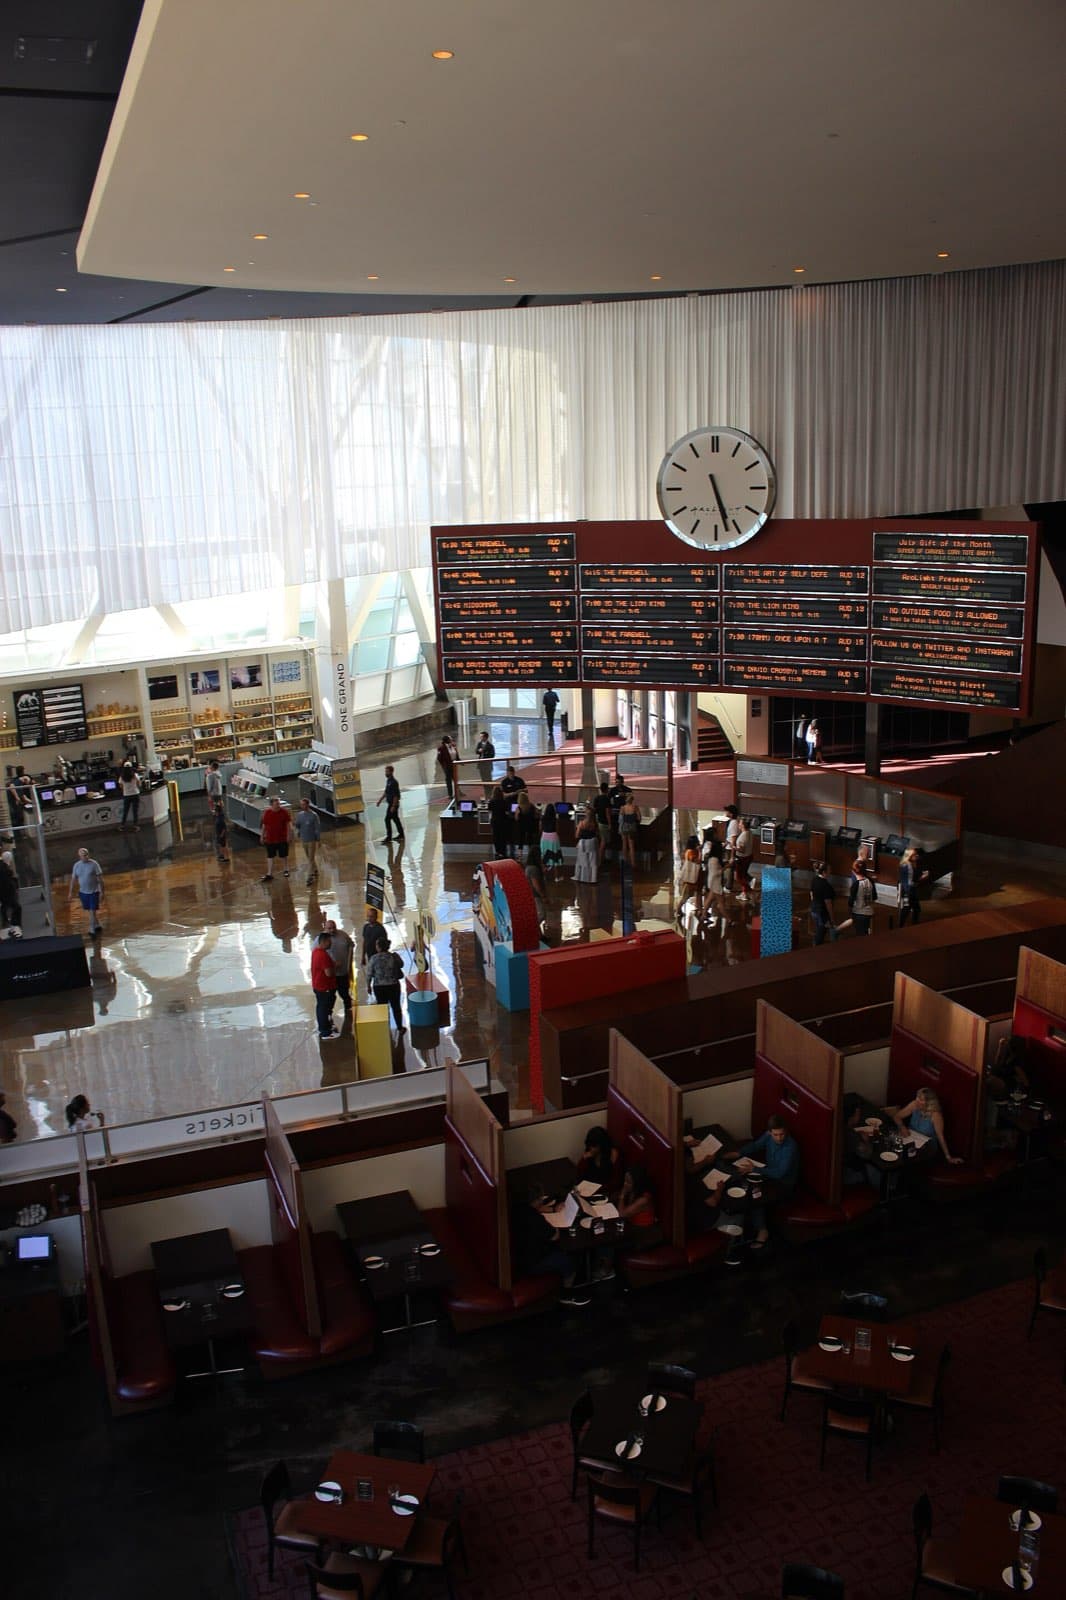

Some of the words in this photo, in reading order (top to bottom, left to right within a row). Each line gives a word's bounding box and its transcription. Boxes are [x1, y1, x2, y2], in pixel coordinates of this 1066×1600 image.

[970, 541, 992, 549] Month
[902, 574, 935, 582] ArcLight
[901, 608, 931, 616] OUTSIDE
[967, 612, 998, 620] ALLOWED
[912, 642, 921, 650] ON
[925, 644, 954, 652] TWITTER
[957, 646, 971, 654] AND
[975, 648, 1014, 657] INSTAGRAM
[337, 663, 347, 705] GRAND
[896, 675, 924, 684] Advance
[928, 678, 957, 687] Tickets
[960, 681, 986, 689] Alert!
[340, 708, 349, 732] ONE
